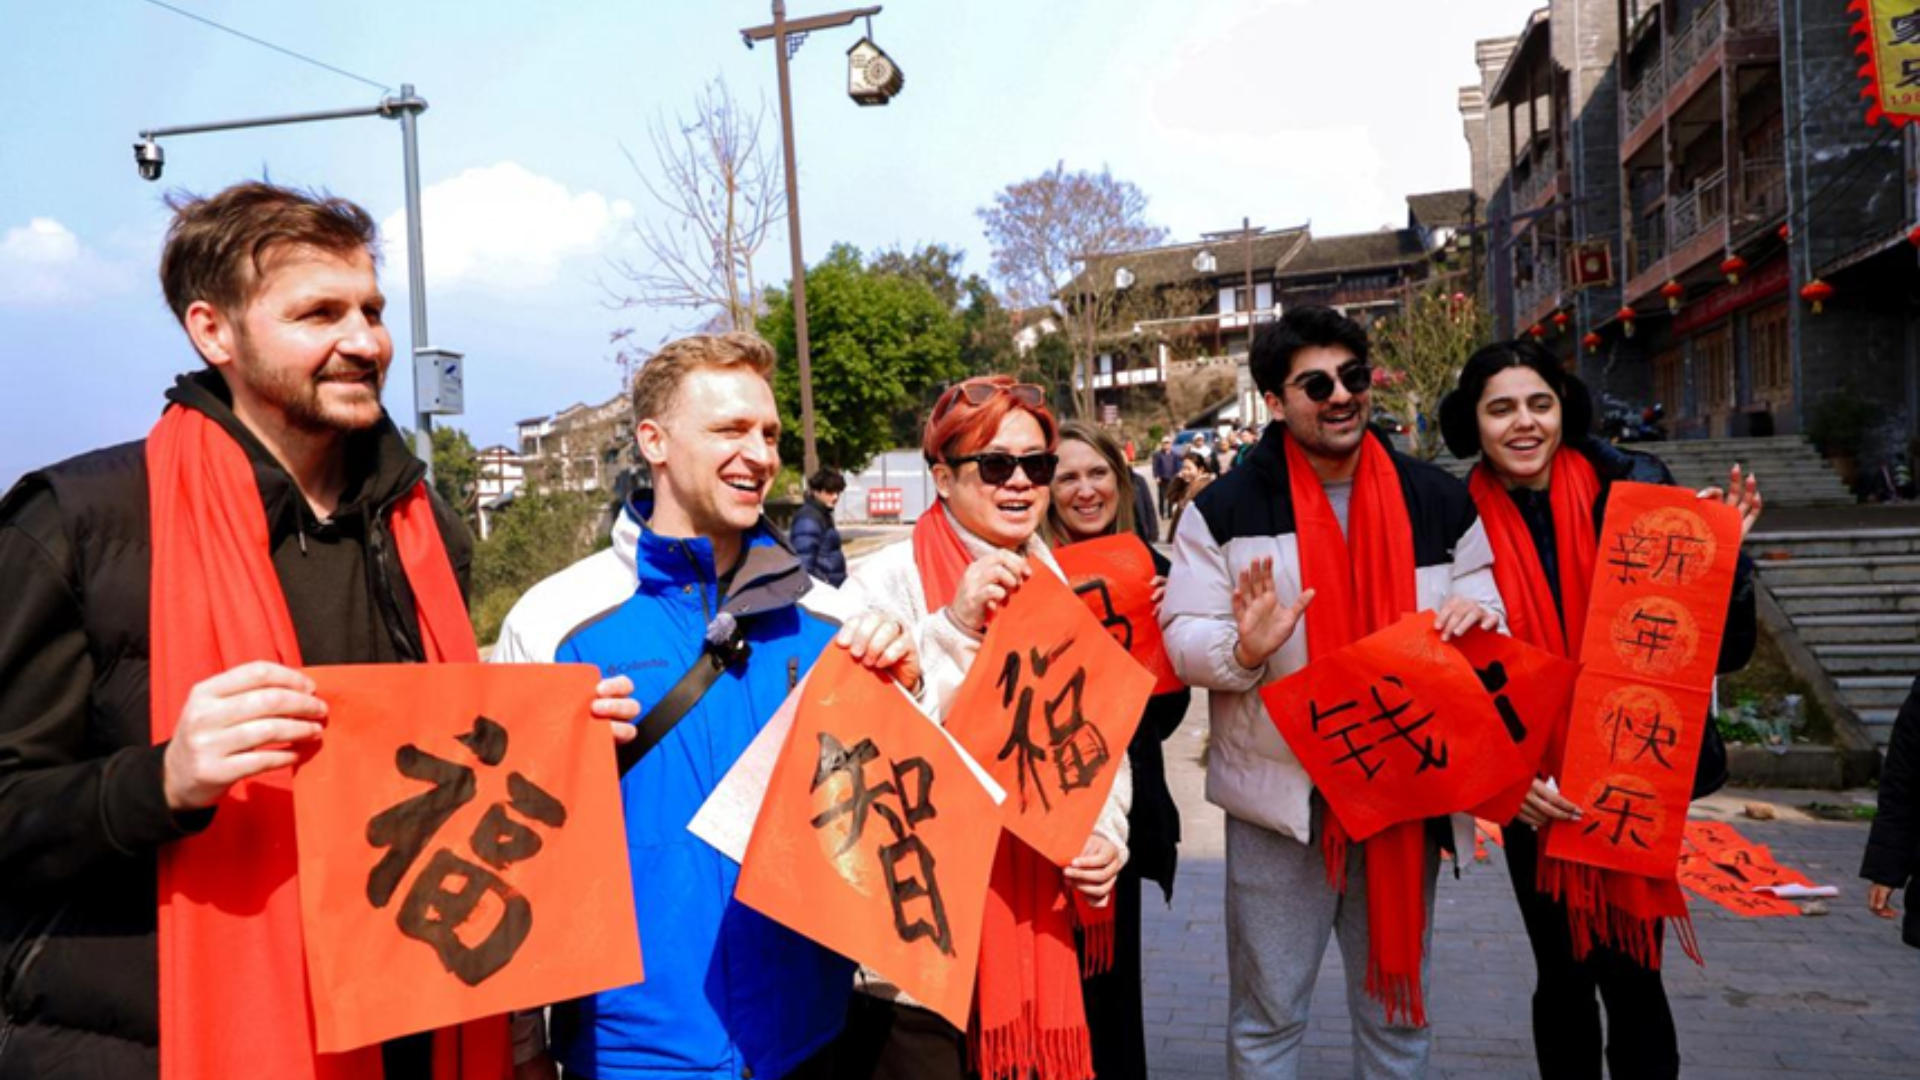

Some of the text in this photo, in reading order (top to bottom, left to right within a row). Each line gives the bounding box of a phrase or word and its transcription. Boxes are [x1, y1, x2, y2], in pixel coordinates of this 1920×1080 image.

[997, 632, 1109, 816] 福
[1309, 676, 1448, 780] 钱
[1583, 525, 1706, 850] 新年快乐
[366, 715, 567, 988] 福
[809, 731, 957, 959] 智
